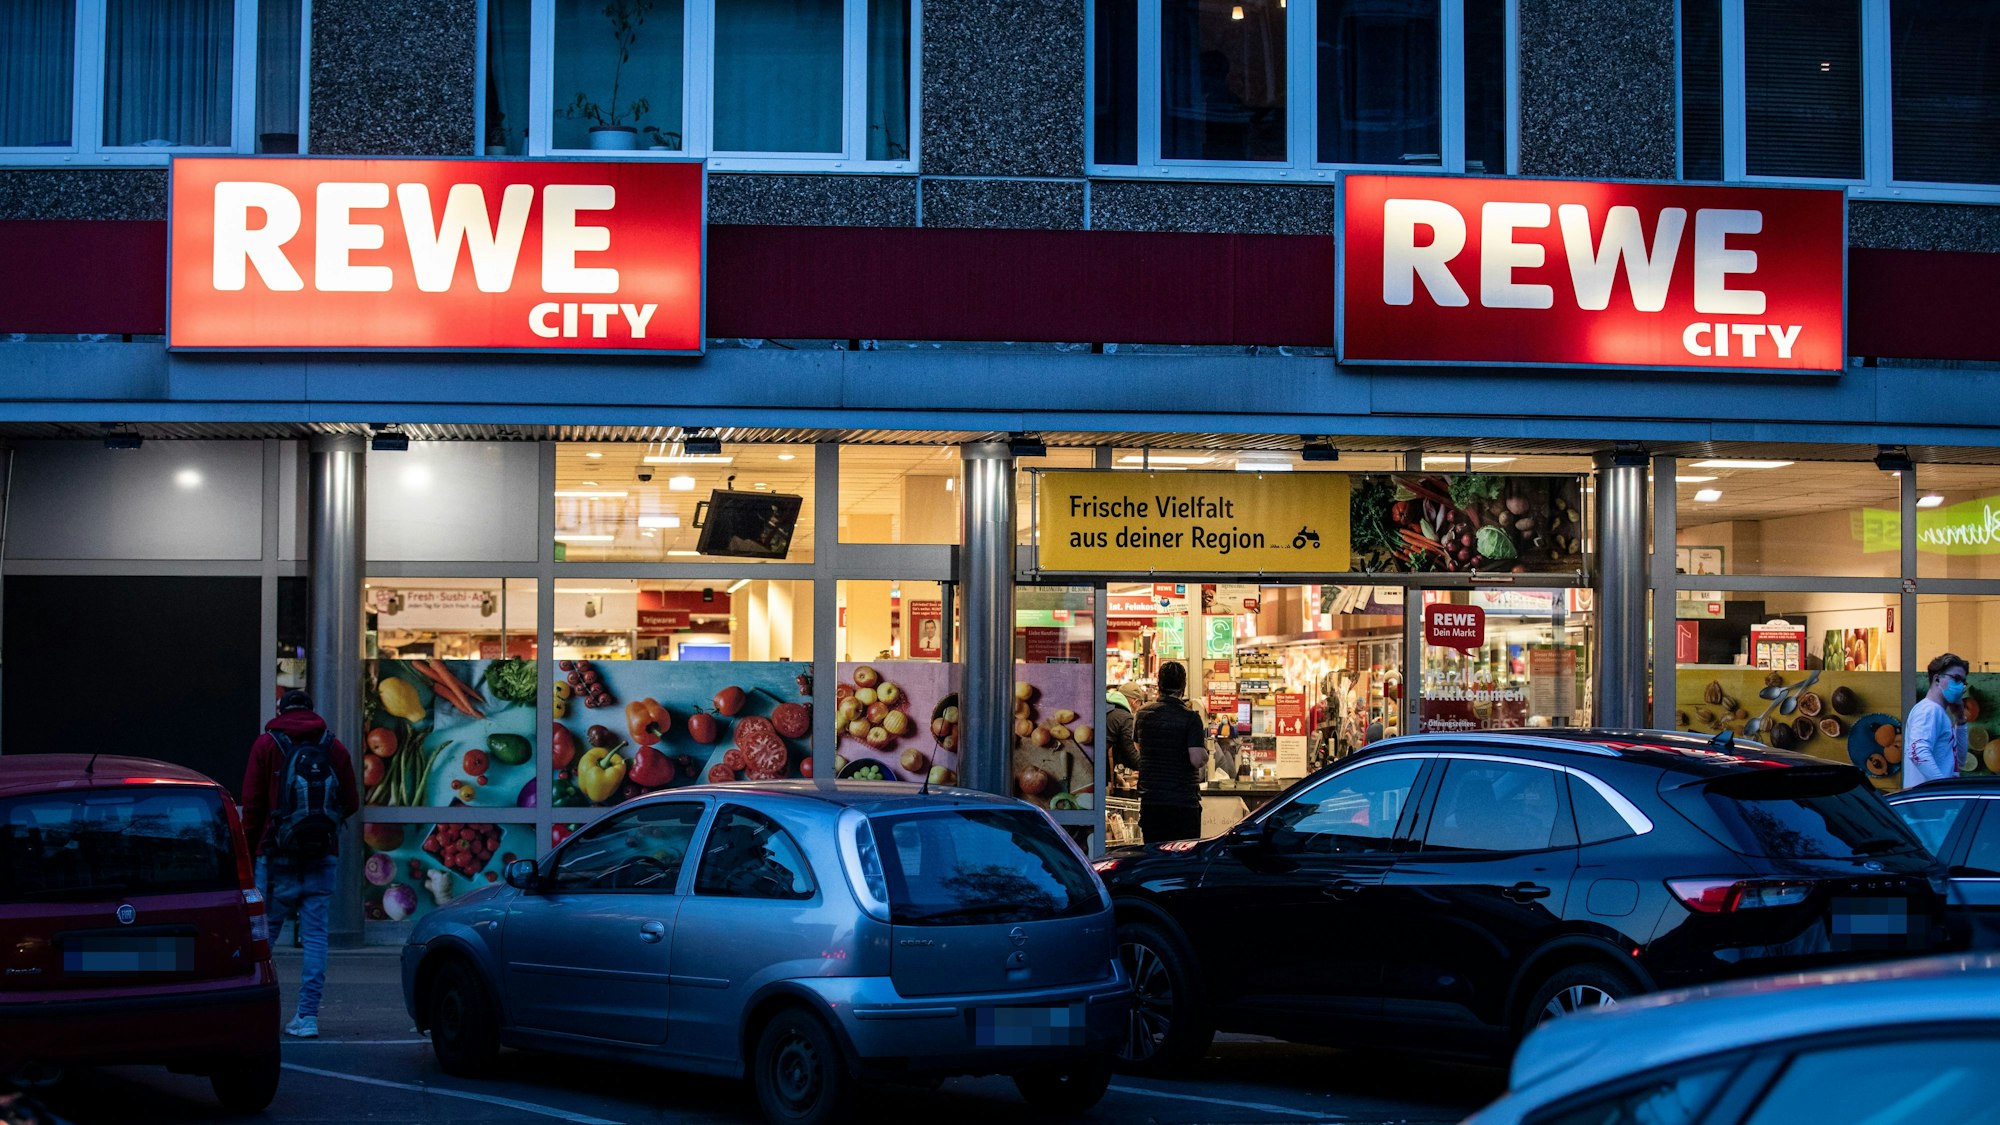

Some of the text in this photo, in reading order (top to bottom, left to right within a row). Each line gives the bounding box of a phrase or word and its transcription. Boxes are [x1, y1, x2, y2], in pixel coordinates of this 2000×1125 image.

[212, 181, 620, 294] REWE
[1383, 198, 1767, 316] REWE
[528, 302, 659, 339] CITY
[1682, 322, 1803, 359] CITY
[1069, 495, 1234, 519] Frische Vielfalt
[1069, 526, 1265, 555] aus deiner Region
[408, 592, 435, 601] Fresh
[440, 592, 467, 601] Sushi
[642, 616, 677, 625] Teigwaren
[1433, 613, 1476, 627] REWE
[1433, 628, 1476, 638] Dein Markt
[1425, 668, 1493, 684] Herzlich
[1425, 686, 1524, 702] willkommen
[121, 909, 133, 920] FIAT
